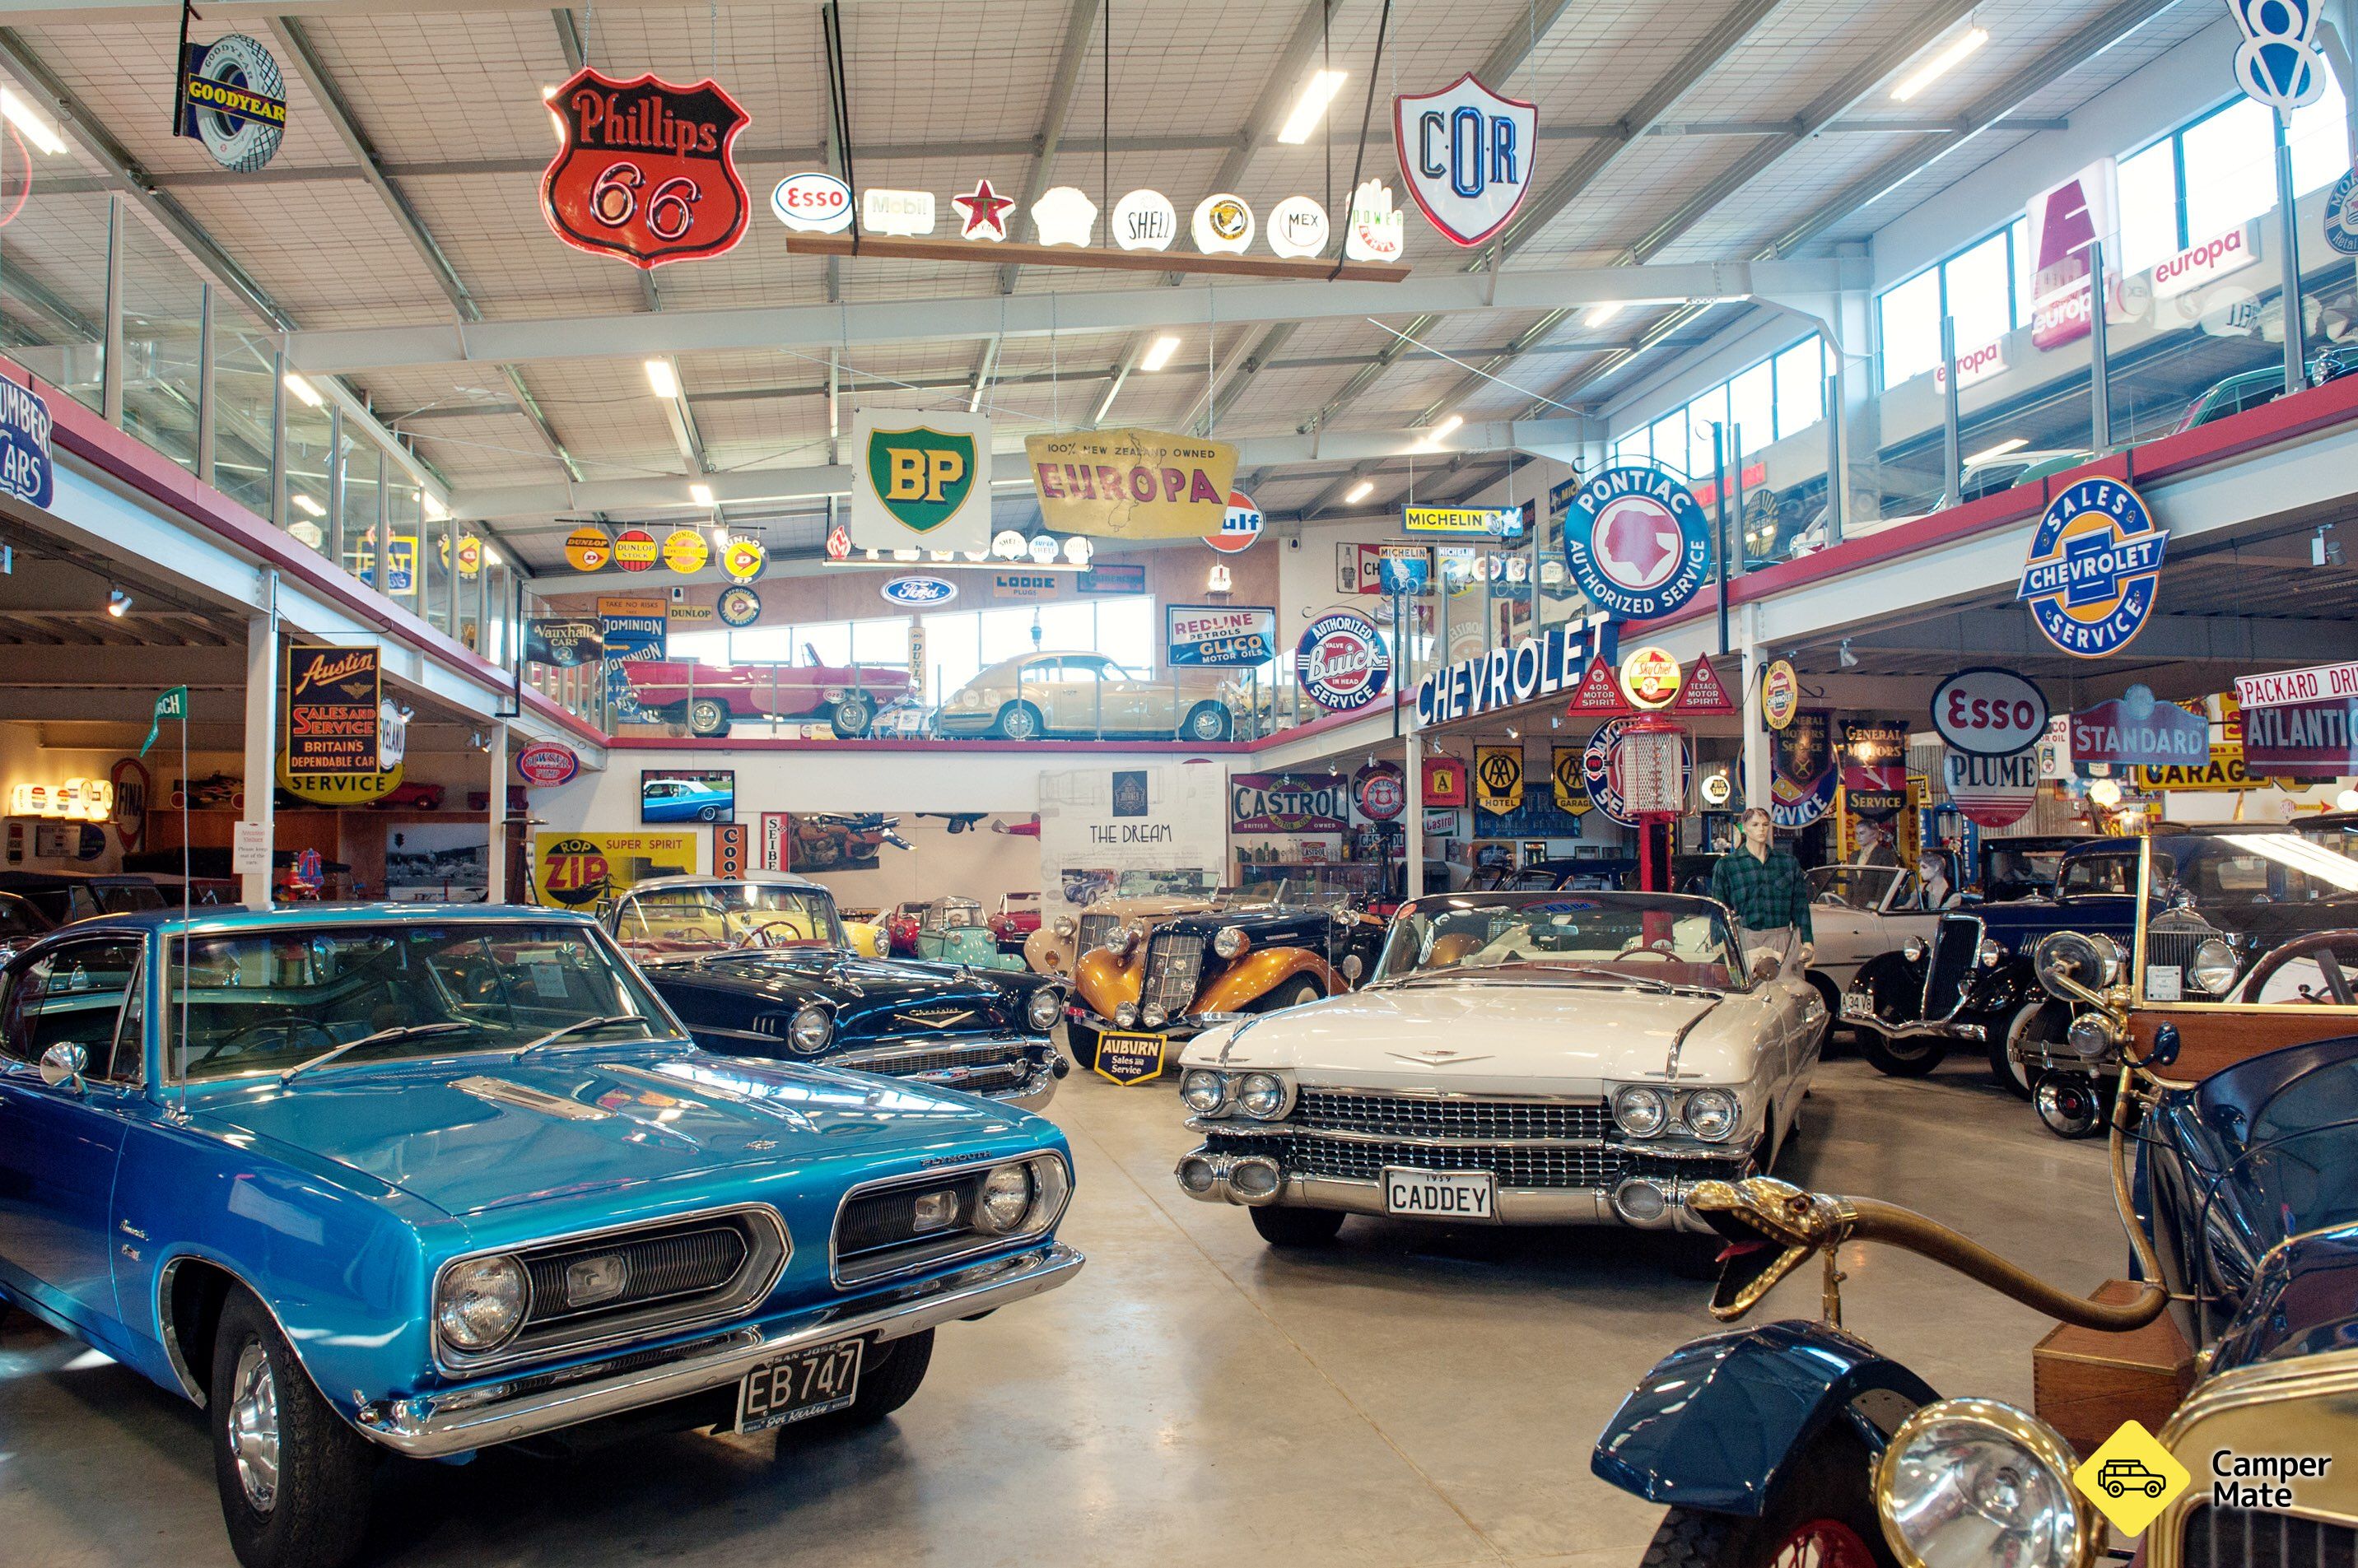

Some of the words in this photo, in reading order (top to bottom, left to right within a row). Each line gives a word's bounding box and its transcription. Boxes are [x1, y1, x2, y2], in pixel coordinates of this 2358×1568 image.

[205, 44, 253, 80] GOODYEAR
[189, 81, 286, 122] GOODYEAR
[571, 89, 718, 165] Phillips
[588, 161, 703, 243] 66
[787, 186, 843, 207] Esso
[872, 195, 927, 216] Mobil
[1128, 210, 1171, 240] SHELL
[1289, 212, 1319, 239] MEX
[1353, 208, 1404, 232] POWER
[1358, 225, 1396, 254] ETHYL
[2155, 230, 2241, 283] europa
[1936, 342, 1998, 382] eropa
[0, 381, 49, 460] UMBER
[1047, 442, 1076, 456] 100%
[1083, 445, 1107, 454] NEW
[1114, 446, 1167, 458] ZEALAND
[1172, 448, 1216, 459] OWNED
[884, 446, 968, 505] BP
[1036, 462, 1223, 505] EUROPA
[1577, 470, 1692, 515] PONTIAC
[2047, 484, 2128, 533] SALES
[1222, 513, 1261, 531] ulf
[1408, 513, 1483, 528] MICHELIN
[1750, 514, 1772, 531] NASH
[566, 538, 608, 548] DUNLOP
[669, 531, 701, 542] DUNLOP
[719, 535, 767, 559] DUNLOP
[1381, 547, 1428, 558] MICHELIN
[1438, 547, 1476, 557] MICHELIN
[363, 553, 411, 573] FAT
[2029, 542, 2153, 590] CHEVROLET
[996, 575, 1056, 589] LODGE
[1569, 539, 1656, 614] AUTHORIZED
[1661, 539, 1706, 608] SERVICE
[897, 580, 940, 601] Ford
[1013, 589, 1037, 597] PLUGS
[671, 609, 711, 618] DUNLOP
[534, 623, 598, 639] Vauxhall
[603, 618, 663, 636] DOMINION
[1174, 612, 1254, 635] REDLINE
[1312, 616, 1373, 640] AUTHORIZED
[2048, 597, 2143, 649] SERVICE
[550, 638, 580, 647] CARS
[1189, 628, 1242, 642] PETROLS
[1199, 635, 1263, 656] GLICO
[1202, 653, 1237, 663] MOTOR
[1242, 649, 1264, 659] OILS
[1305, 638, 1385, 685] Buick
[294, 652, 375, 696] Austin
[1415, 611, 1611, 727] CHEVROLET
[1638, 662, 1653, 677] Sky
[1653, 662, 1672, 674] Chief
[1583, 691, 1615, 699] MOTOR
[1688, 690, 1719, 698] MOTOR
[2244, 672, 2318, 705] PACKARD
[2329, 667, 2358, 694] DRI
[1310, 684, 1376, 709] SERVICE
[1582, 698, 1618, 706] SPIRIT.
[1685, 697, 1722, 705] SPIRIT.
[1767, 692, 1795, 706] CHEVROLET
[349, 708, 376, 720] AND
[1947, 688, 2035, 731] Esso
[1773, 717, 1789, 727] PARTS
[1792, 716, 1825, 727] NERAL
[1846, 725, 1902, 741] GENERAL
[1847, 743, 1903, 758] MOTORS
[291, 756, 352, 768] DEPENDABLE
[355, 756, 375, 768] CAR
[1587, 759, 1603, 767] FRY
[1949, 754, 2037, 788] PLUME
[1488, 757, 1512, 787] AA
[292, 775, 387, 792] SERVICE
[1368, 779, 1398, 794] UNION
[117, 781, 143, 817] FINA
[1234, 786, 1348, 823] CASTROL
[1484, 799, 1517, 807] HOTEL
[1850, 793, 1903, 808] SERVICE
[1771, 792, 1828, 826] RVICE
[1426, 813, 1455, 831] Castrol
[1089, 824, 1117, 844] THE
[1122, 824, 1172, 843] DREAM
[1360, 834, 1404, 847] CASOL
[560, 839, 591, 854] ROP
[605, 839, 642, 850] SUPER
[649, 839, 683, 850] SPIRIT
[1302, 846, 1327, 857] CASTROL
[721, 828, 739, 881] Coo
[543, 855, 610, 889] ZIP
[1848, 996, 1859, 1010] 34
[1861, 998, 1873, 1012] V8
[1101, 1039, 1160, 1057] AUBURN
[1111, 1054, 1135, 1064] Sales
[1111, 1063, 1142, 1075] Service
[920, 1150, 993, 1166] PLYMOUTH
[1426, 1175, 1452, 1183] 1959
[1392, 1184, 1487, 1212] CADDEY
[773, 1352, 799, 1364] SAN
[803, 1345, 838, 1357] JOSE
[747, 1365, 793, 1415] EB
[800, 1348, 856, 1400] 747
